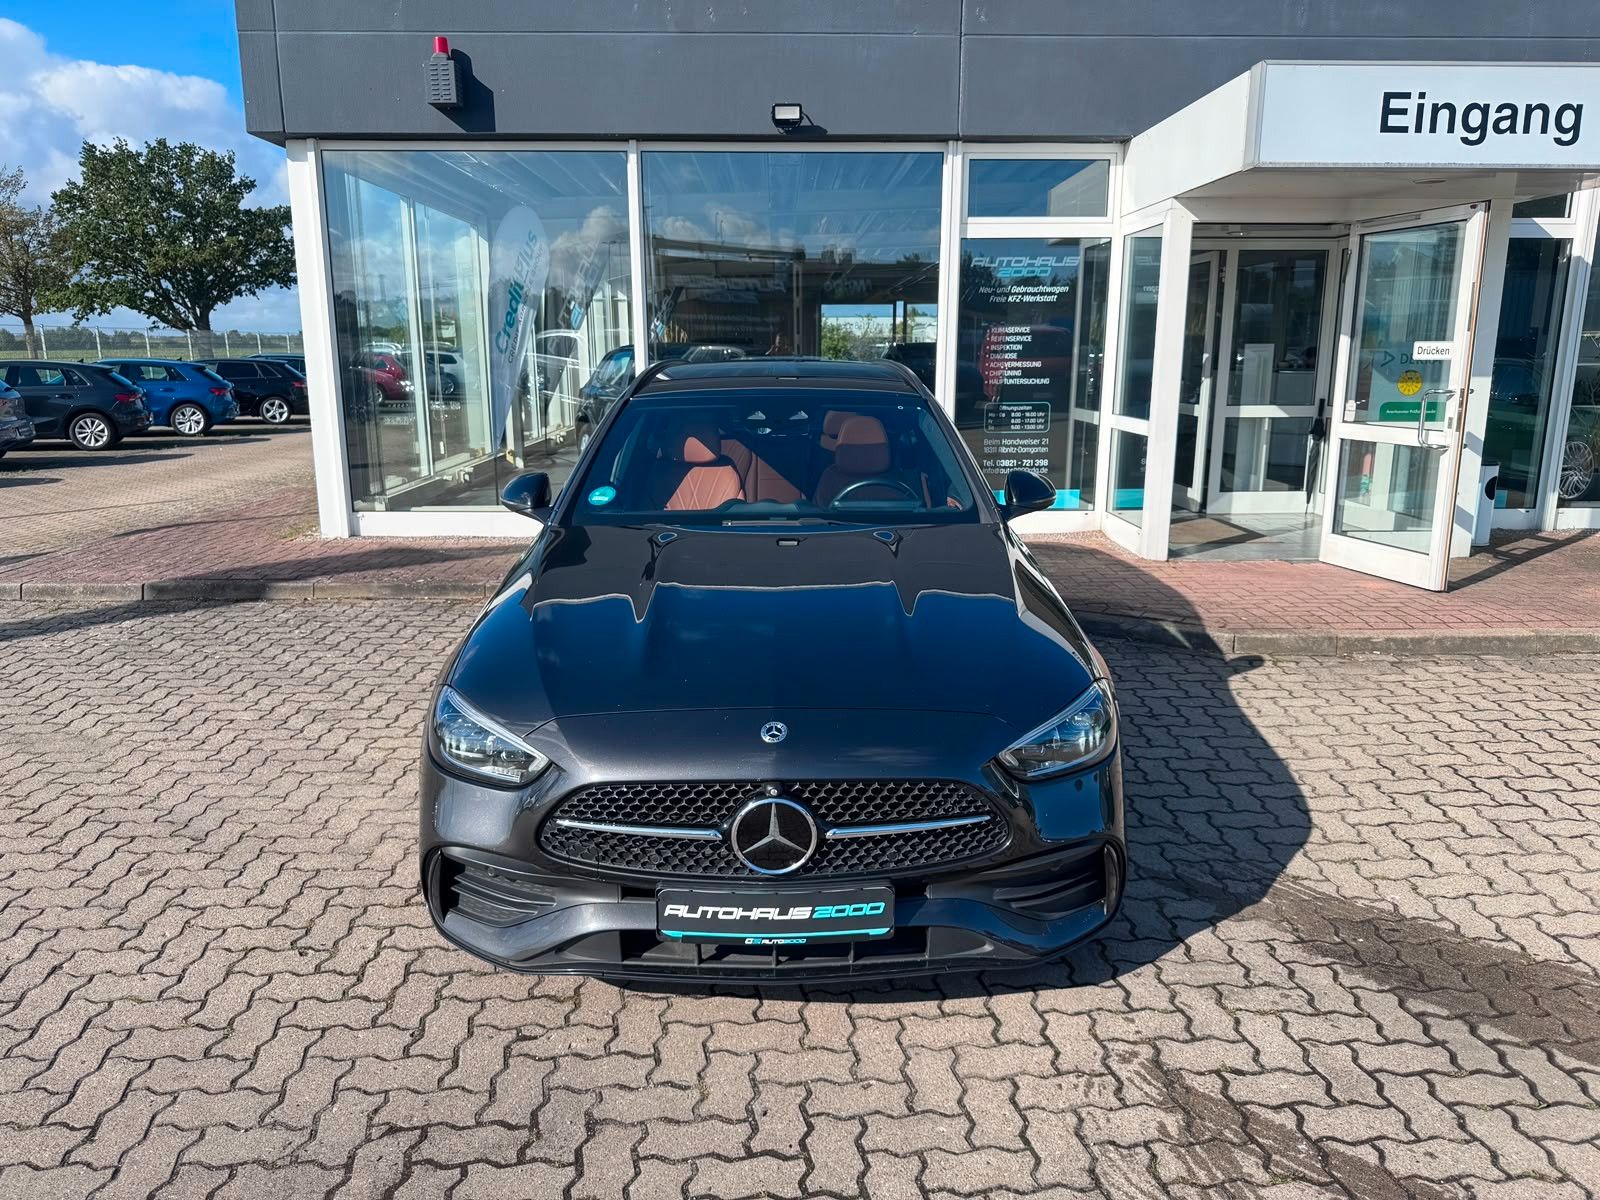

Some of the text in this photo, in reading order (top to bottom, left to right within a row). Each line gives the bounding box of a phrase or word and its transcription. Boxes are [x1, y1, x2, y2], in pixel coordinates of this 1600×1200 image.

[1379, 91, 1584, 147] Eingang
[970, 255, 1080, 267] AUTOHAUS
[996, 267, 1051, 278] 2000
[996, 285, 1010, 293] und
[1010, 285, 1069, 293] Gebrauchtwagen
[1417, 346, 1450, 355] Drücken
[998, 446, 1049, 454] Ribnitz-Damgarten
